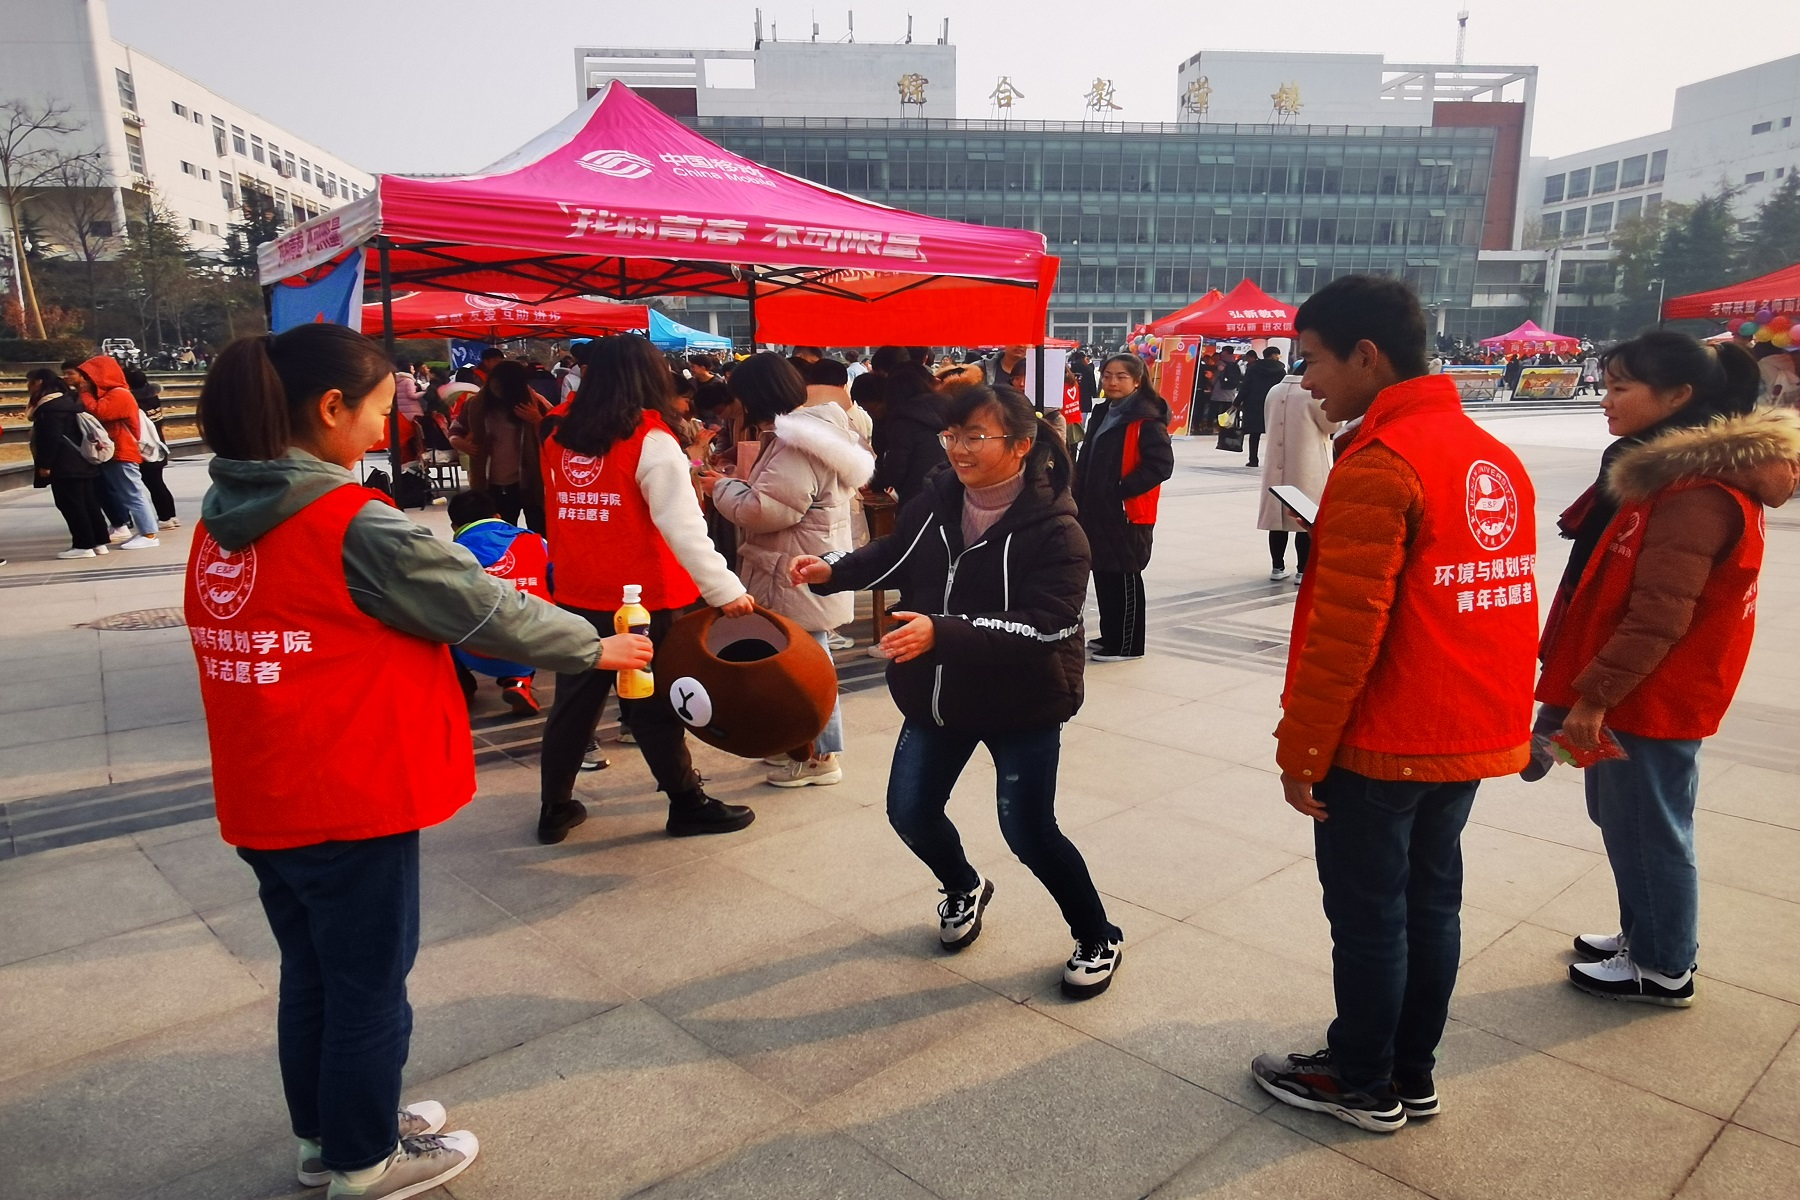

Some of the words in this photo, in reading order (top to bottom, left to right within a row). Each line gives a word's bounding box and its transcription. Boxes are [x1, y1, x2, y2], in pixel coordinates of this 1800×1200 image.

[659, 153, 765, 178] 中国移动
[673, 167, 722, 180] China
[566, 207, 748, 246] 我的青春
[760, 223, 922, 259] 不可限量
[468, 309, 497, 322] 友爱
[501, 308, 529, 322] 互助
[1228, 309, 1287, 319] 弘新教育
[1710, 301, 1756, 315] 考研联盟
[557, 491, 621, 506] 境与规划学院
[216, 565, 236, 574] E&P
[514, 577, 538, 587] 学院
[1456, 582, 1532, 613] 青年志愿者
